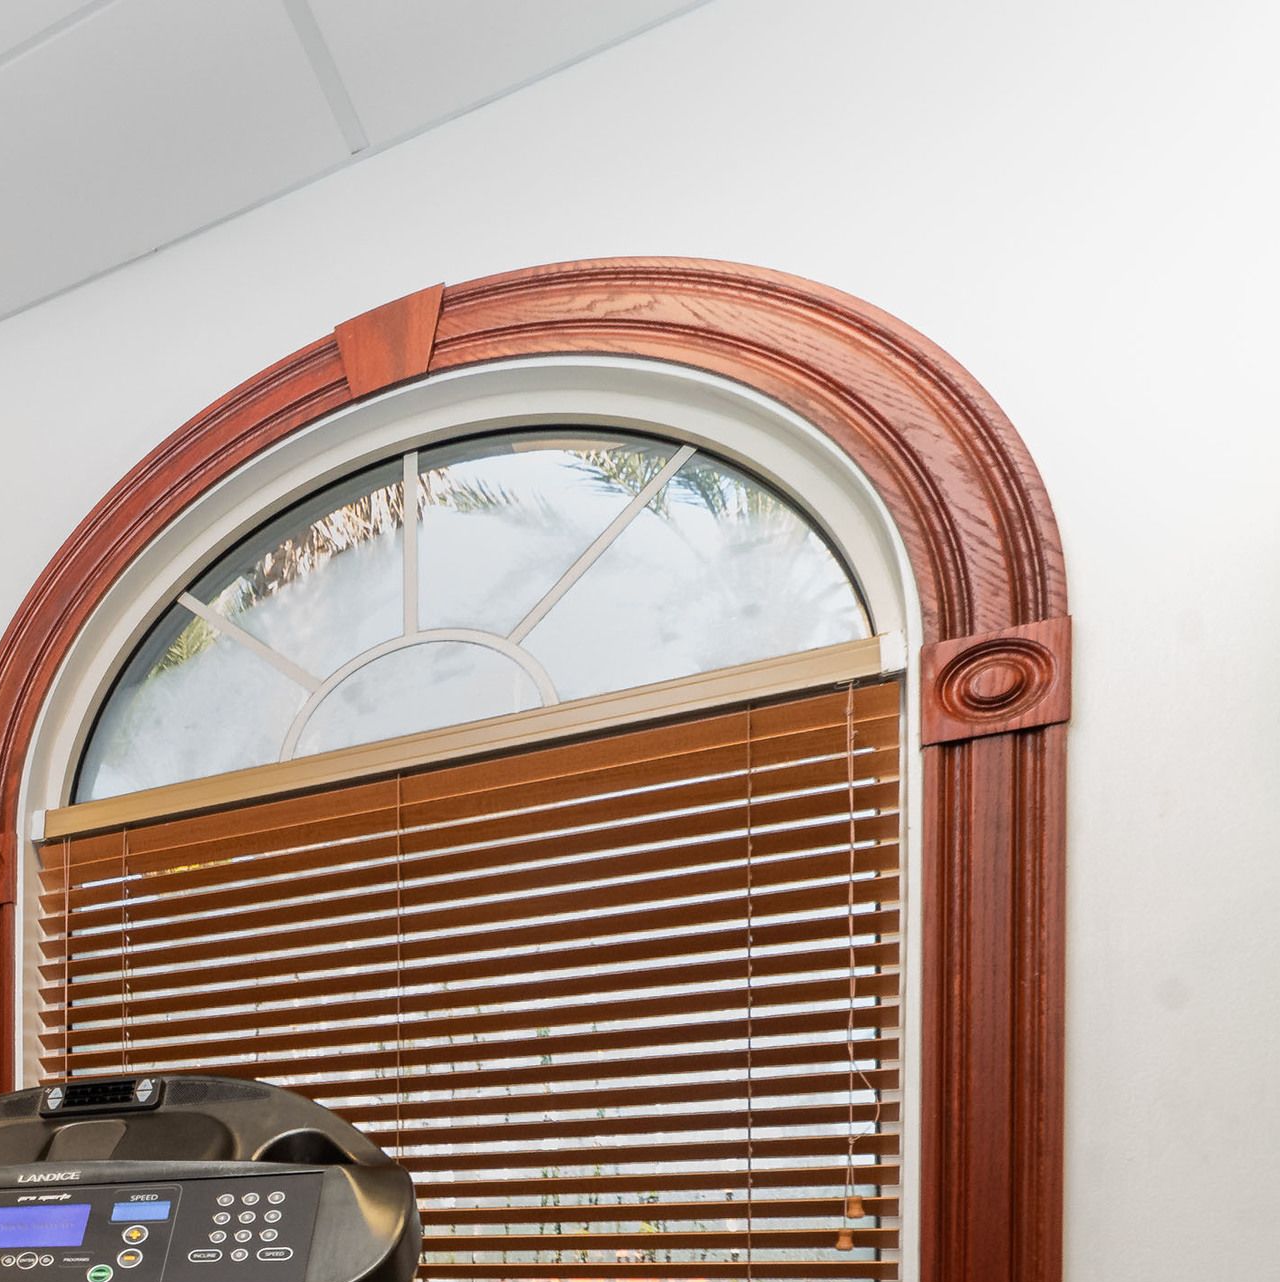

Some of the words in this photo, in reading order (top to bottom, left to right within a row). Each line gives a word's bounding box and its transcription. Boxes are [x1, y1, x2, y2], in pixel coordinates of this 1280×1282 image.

[17, 1171, 82, 1183] LANDICE
[17, 1195, 37, 1203] pro
[130, 1194, 159, 1202] SPEED
